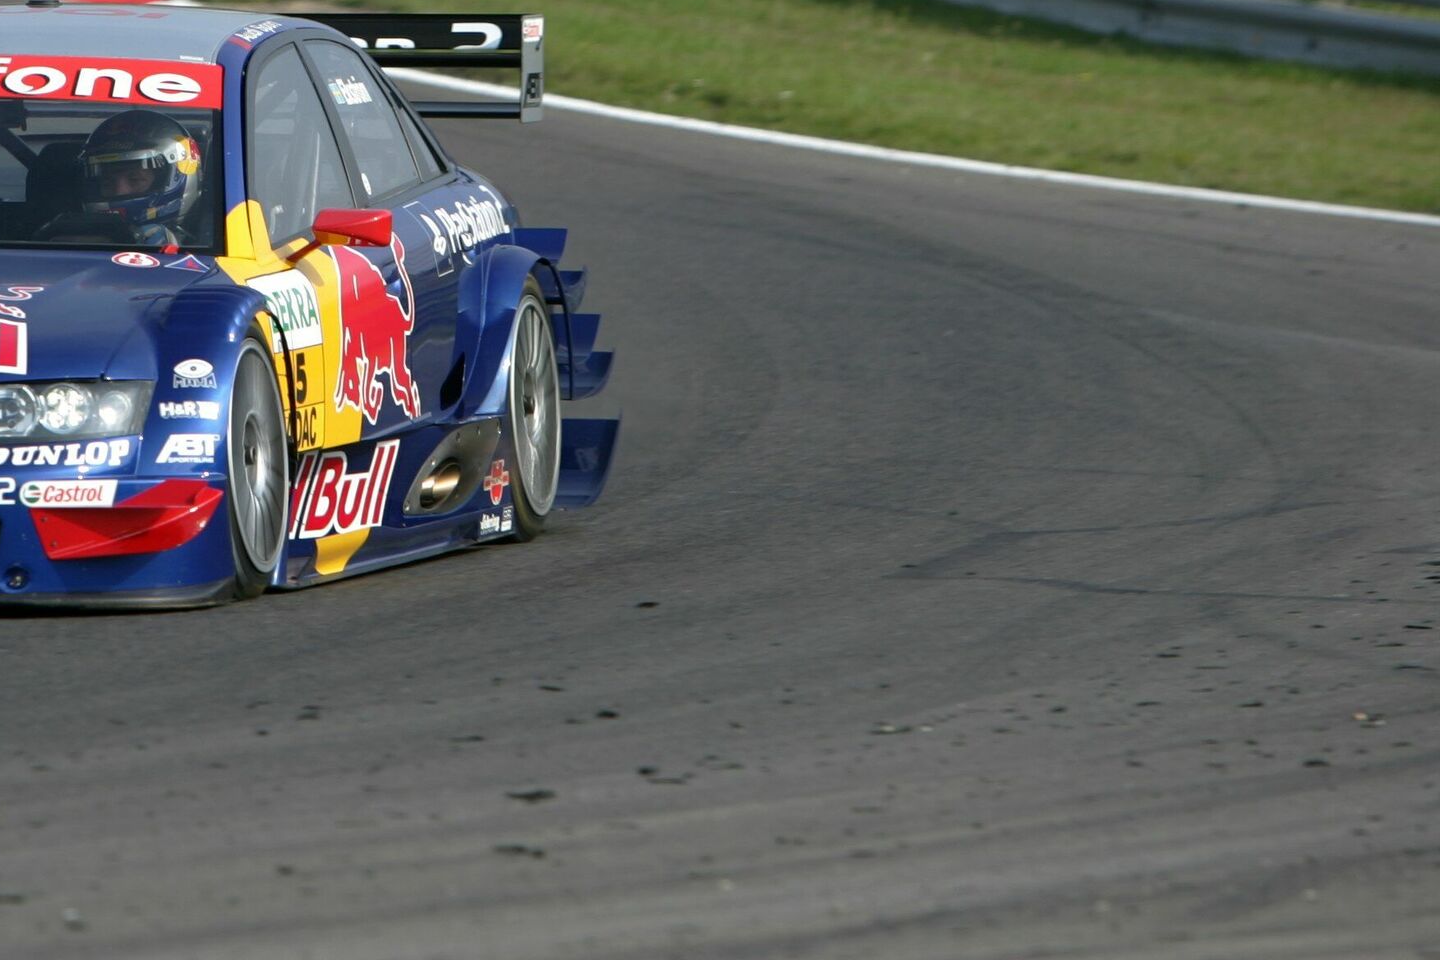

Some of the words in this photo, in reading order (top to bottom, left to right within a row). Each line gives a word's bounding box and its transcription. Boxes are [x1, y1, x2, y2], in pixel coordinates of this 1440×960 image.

[156, 434, 220, 463] ABT
[43, 484, 104, 503] Castrol
[301, 441, 398, 537] Bull
